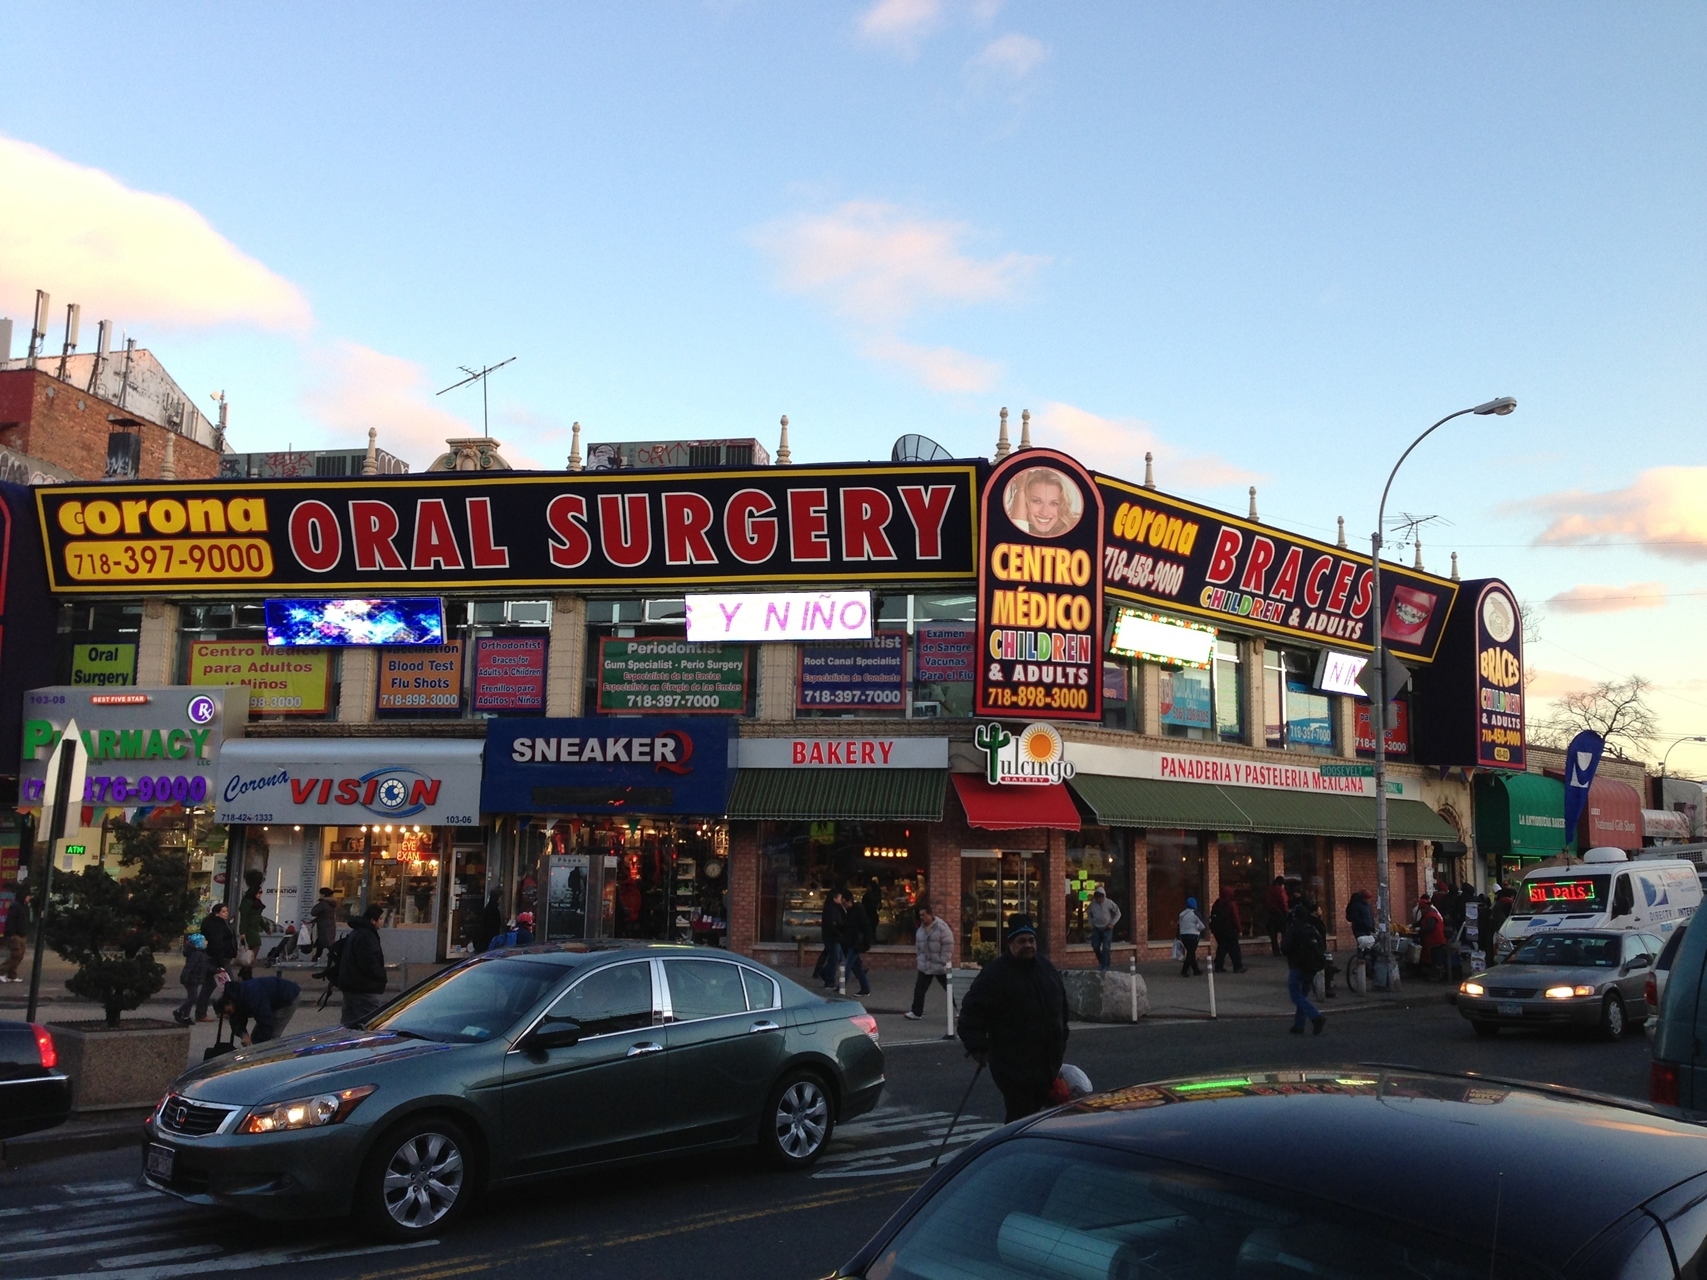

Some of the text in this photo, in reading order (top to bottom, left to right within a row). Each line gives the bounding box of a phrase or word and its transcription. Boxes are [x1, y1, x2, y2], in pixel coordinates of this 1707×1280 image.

[288, 497, 509, 573] ORAL
[546, 485, 956, 570] SURGERY
[73, 543, 264, 575] 718-397-9000
[991, 542, 1091, 587] CENTRO
[1105, 546, 1185, 597] 718-458-9000
[1205, 525, 1374, 619] BRACES
[991, 586, 1091, 631] MÉDICO
[1200, 586, 1363, 640] CHILDREN & ADULTS
[719, 602, 743, 631] Y
[926, 629, 965, 638] Examen
[197, 646, 255, 657] Centro
[481, 641, 542, 650] Orthodontist
[627, 642, 722, 654] Periodontist
[922, 643, 972, 653] de Sangre
[989, 629, 1091, 664] CHILDREN
[88, 646, 118, 662] Oral
[492, 656, 529, 664] Braces for
[388, 660, 454, 672] Blood Test
[604, 660, 743, 671] Gum Specialist Perio Surgery
[804, 657, 901, 667] Root Canal Specialist
[925, 657, 966, 666] Vacunas
[1480, 646, 1520, 688] BRACES
[203, 661, 313, 676] para Adultos
[478, 668, 502, 677] Adults
[511, 667, 541, 676] Children
[988, 663, 1089, 685] & ADULTS
[74, 670, 129, 687] Surgery
[623, 672, 669, 682] Especialista
[671, 672, 680, 681] de
[682, 672, 694, 681] las
[803, 673, 901, 684] Especialista de Conducto
[920, 671, 974, 680] Para el Flu
[391, 678, 450, 688] Flu Shots
[603, 683, 649, 692] Especialista
[650, 684, 660, 692] en
[691, 683, 700, 692] de
[702, 683, 714, 692] las
[481, 685, 535, 694] Frenillos para
[478, 696, 508, 705] Adultos
[509, 698, 514, 706] y
[627, 695, 720, 707] 718-397-7000
[804, 690, 901, 703] 718-397-7000
[987, 686, 1089, 710] 718-898-3000
[1481, 687, 1520, 716] CHILDREN
[1482, 712, 1520, 729] & ADULTS
[23, 719, 211, 760] PARMACY
[512, 738, 676, 762] SNEAKER
[792, 740, 894, 765] BAKERY
[1161, 756, 1364, 793] PANADERIA Y PASTELERIA MEXICANA
[1322, 766, 1362, 776] ROOSEVELT
[223, 770, 442, 810] Corona VISION
[446, 816, 472, 824] 103-06
[1615, 819, 1623, 831] Gift
[1624, 820, 1635, 833] Shop
[67, 846, 83, 854] ATM
[402, 841, 416, 851] EYE
[397, 851, 420, 861] EXAM
